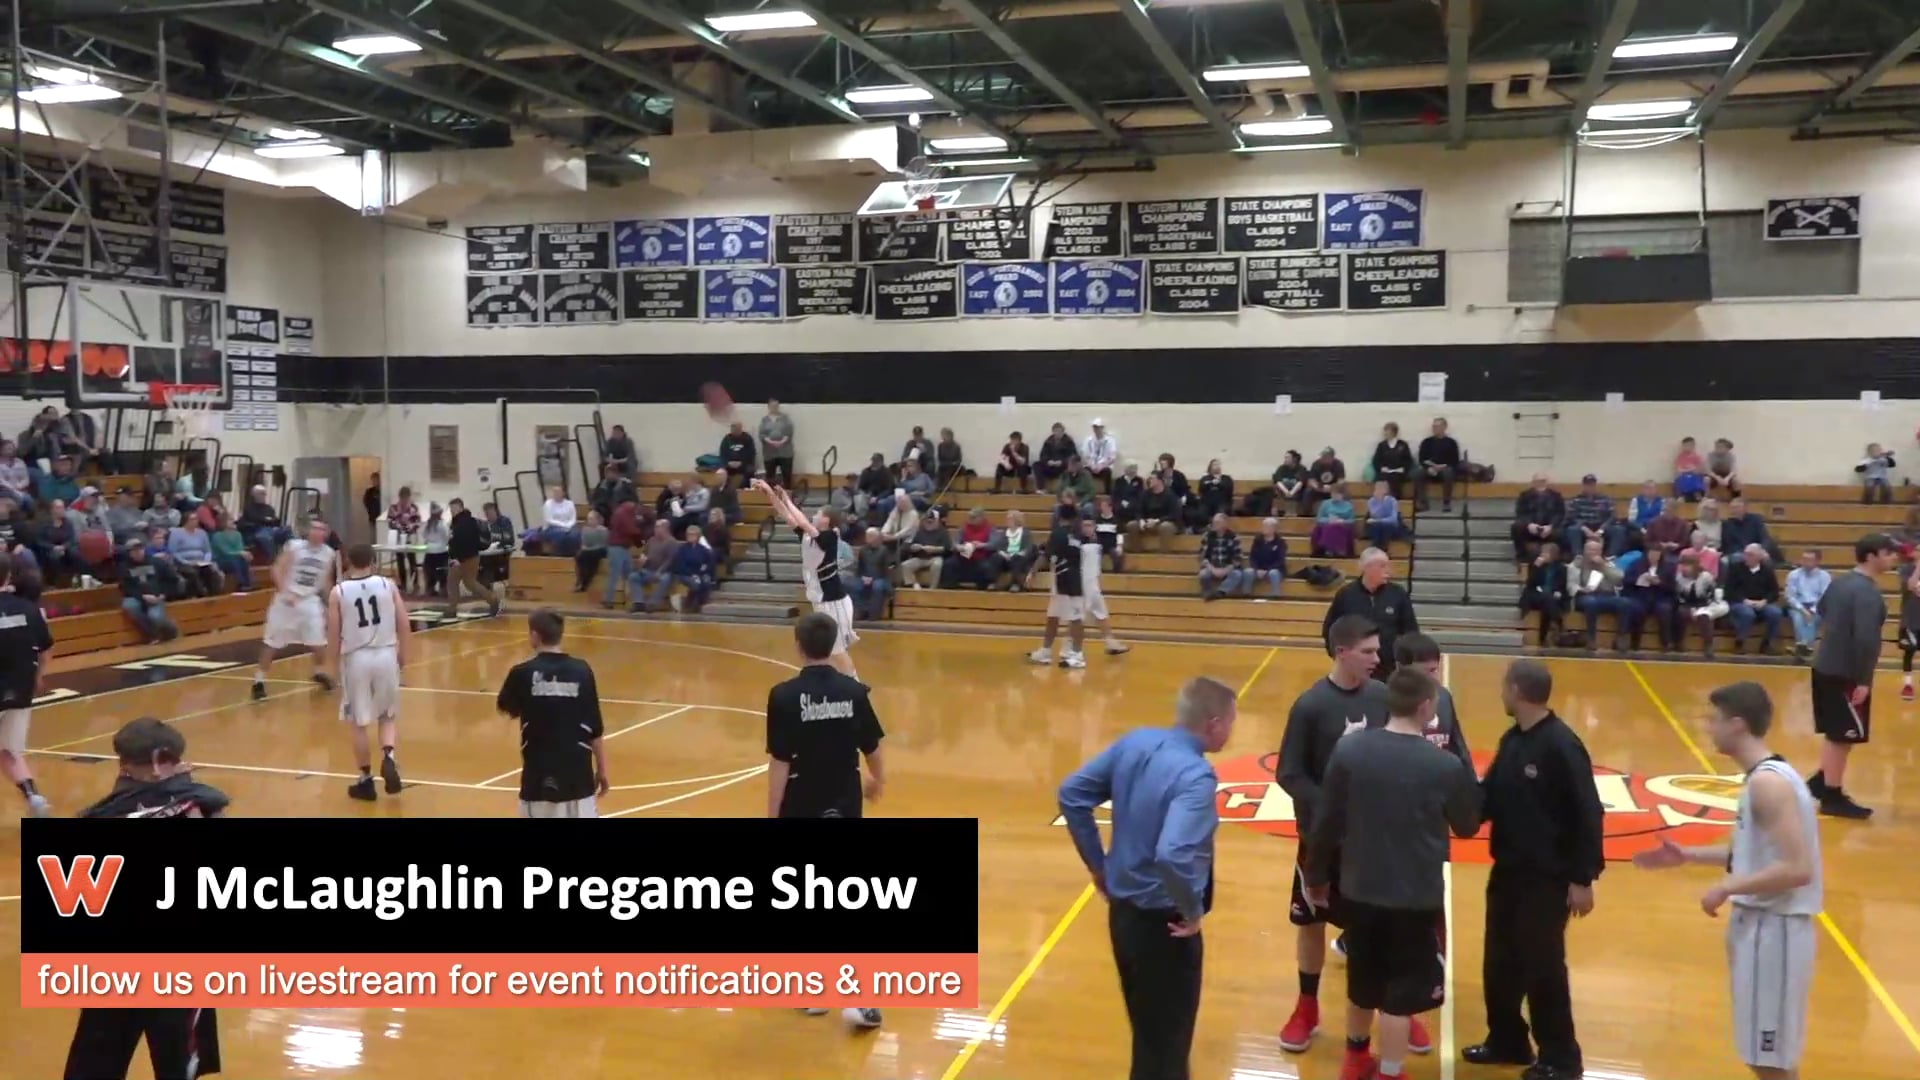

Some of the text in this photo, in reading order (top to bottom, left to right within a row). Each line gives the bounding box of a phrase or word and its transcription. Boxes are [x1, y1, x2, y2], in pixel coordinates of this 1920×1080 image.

[1230, 198, 1313, 212] STATE CHAMPIONS
[1141, 212, 1206, 224] CHAMPIONS
[1227, 211, 1315, 225] BOYS BASKETBALL
[1157, 224, 1189, 232] 2004
[1246, 226, 1297, 236] CLASS C
[1149, 242, 1186, 252] CLASS
[1253, 238, 1287, 248] 2004
[1055, 246, 1092, 254] CLASS
[1248, 258, 1278, 270] STATE
[1354, 254, 1439, 268] STATE CHAMPIONS
[1154, 261, 1235, 274] STATE CHAMPIONS
[1353, 268, 1440, 281] CHEERLEADING
[1152, 274, 1238, 287] CHEERLEADING
[1276, 280, 1309, 289] 2004
[878, 281, 953, 295] CHEERLEADING
[1169, 288, 1220, 298] CLASS C
[1370, 282, 1423, 293] CLASS C
[1263, 289, 1325, 299] SOFTBALL
[892, 295, 926, 306] CLASS
[1178, 300, 1210, 309] 2004
[354, 595, 382, 628] 11
